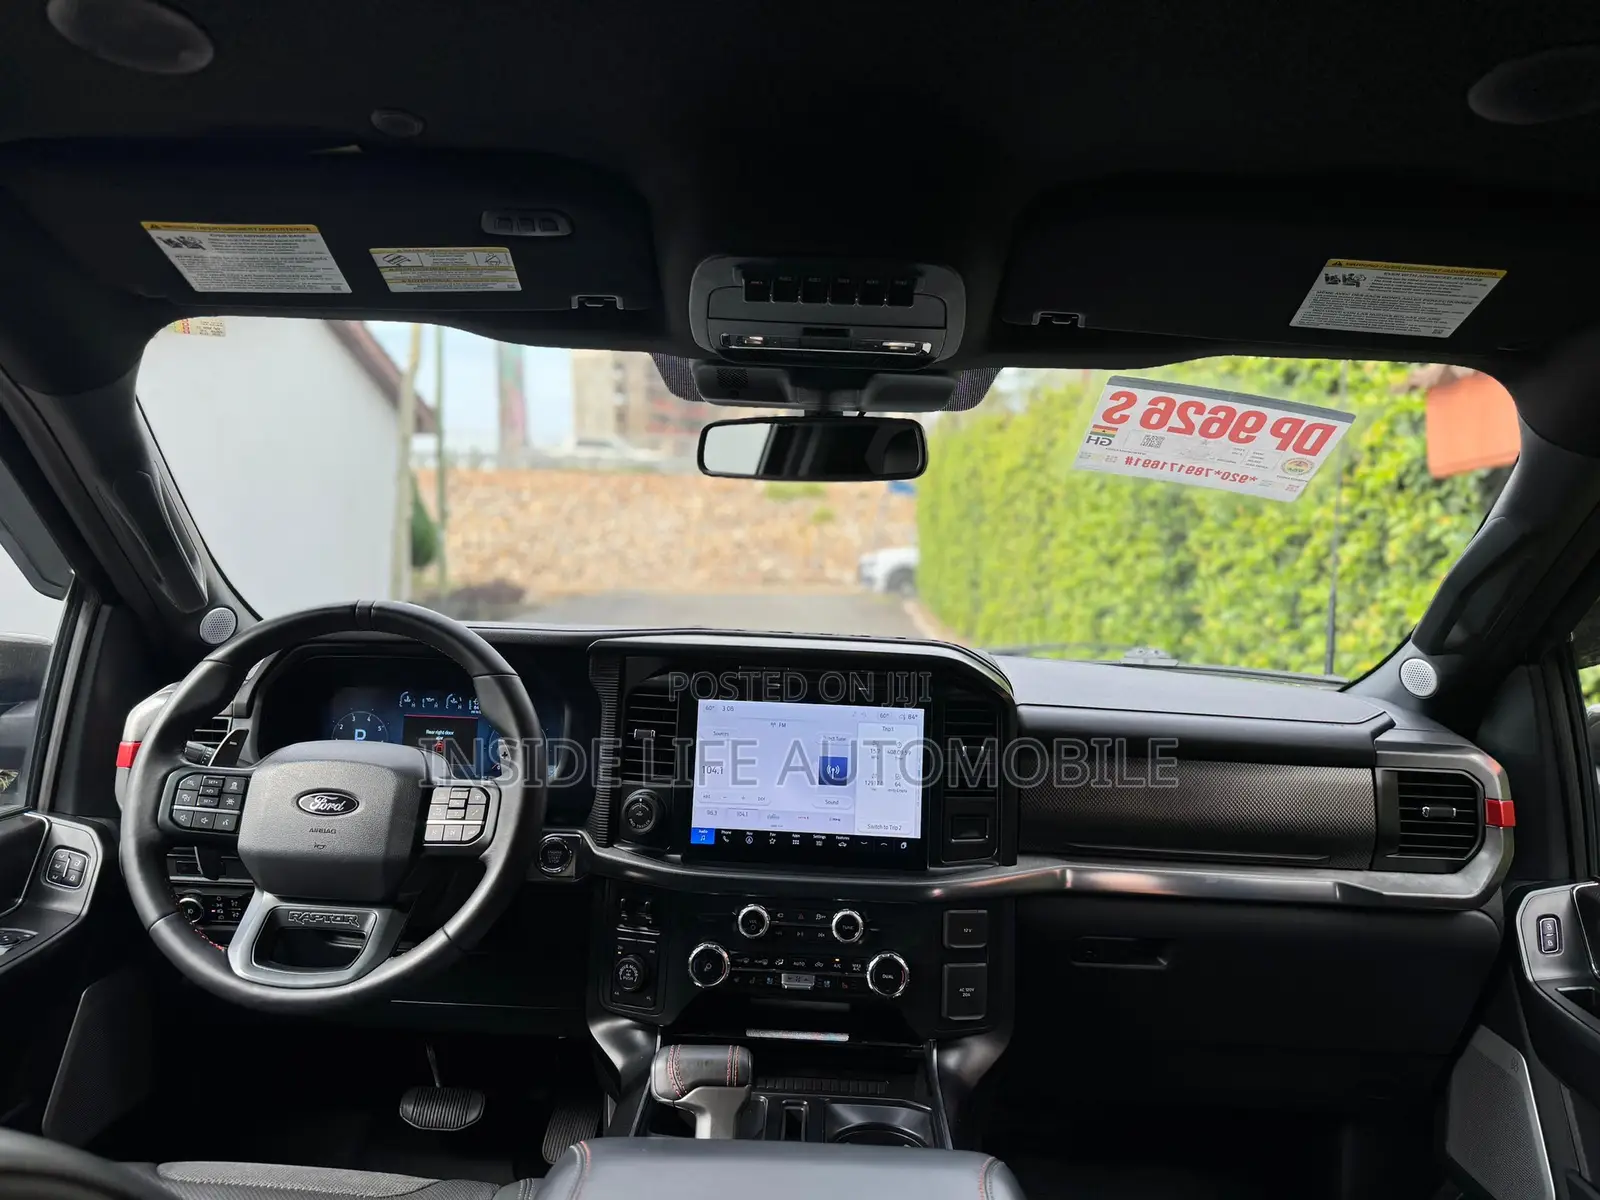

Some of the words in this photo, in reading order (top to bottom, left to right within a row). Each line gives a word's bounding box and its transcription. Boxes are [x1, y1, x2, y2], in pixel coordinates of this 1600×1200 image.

[702, 765, 723, 775] 104.1
[310, 795, 346, 811] Ford
[289, 911, 359, 927] RAPTOR
